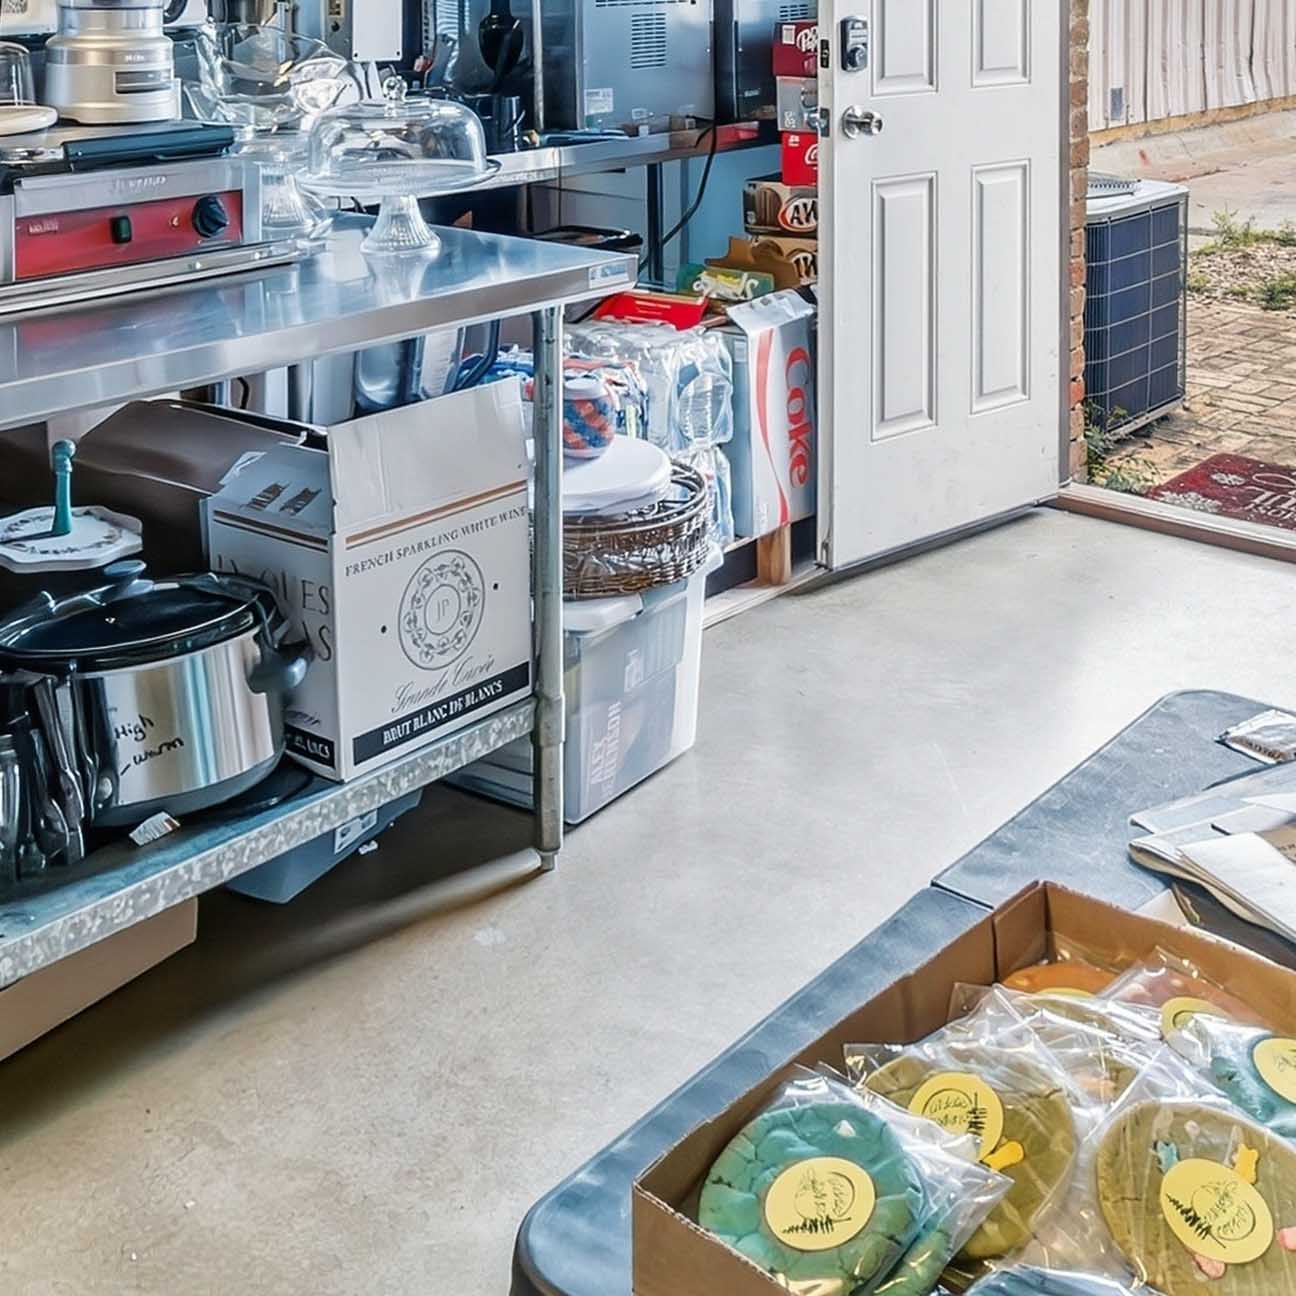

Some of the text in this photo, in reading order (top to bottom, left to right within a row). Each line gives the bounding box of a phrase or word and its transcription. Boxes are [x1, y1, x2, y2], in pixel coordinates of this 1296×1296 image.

[785, 345, 813, 489] Coke
[345, 549, 394, 576] FRENCH
[396, 530, 459, 561] SPARKLING
[461, 516, 498, 538] WHITE
[114, 714, 155, 742] High
[412, 704, 449, 732] BLANC
